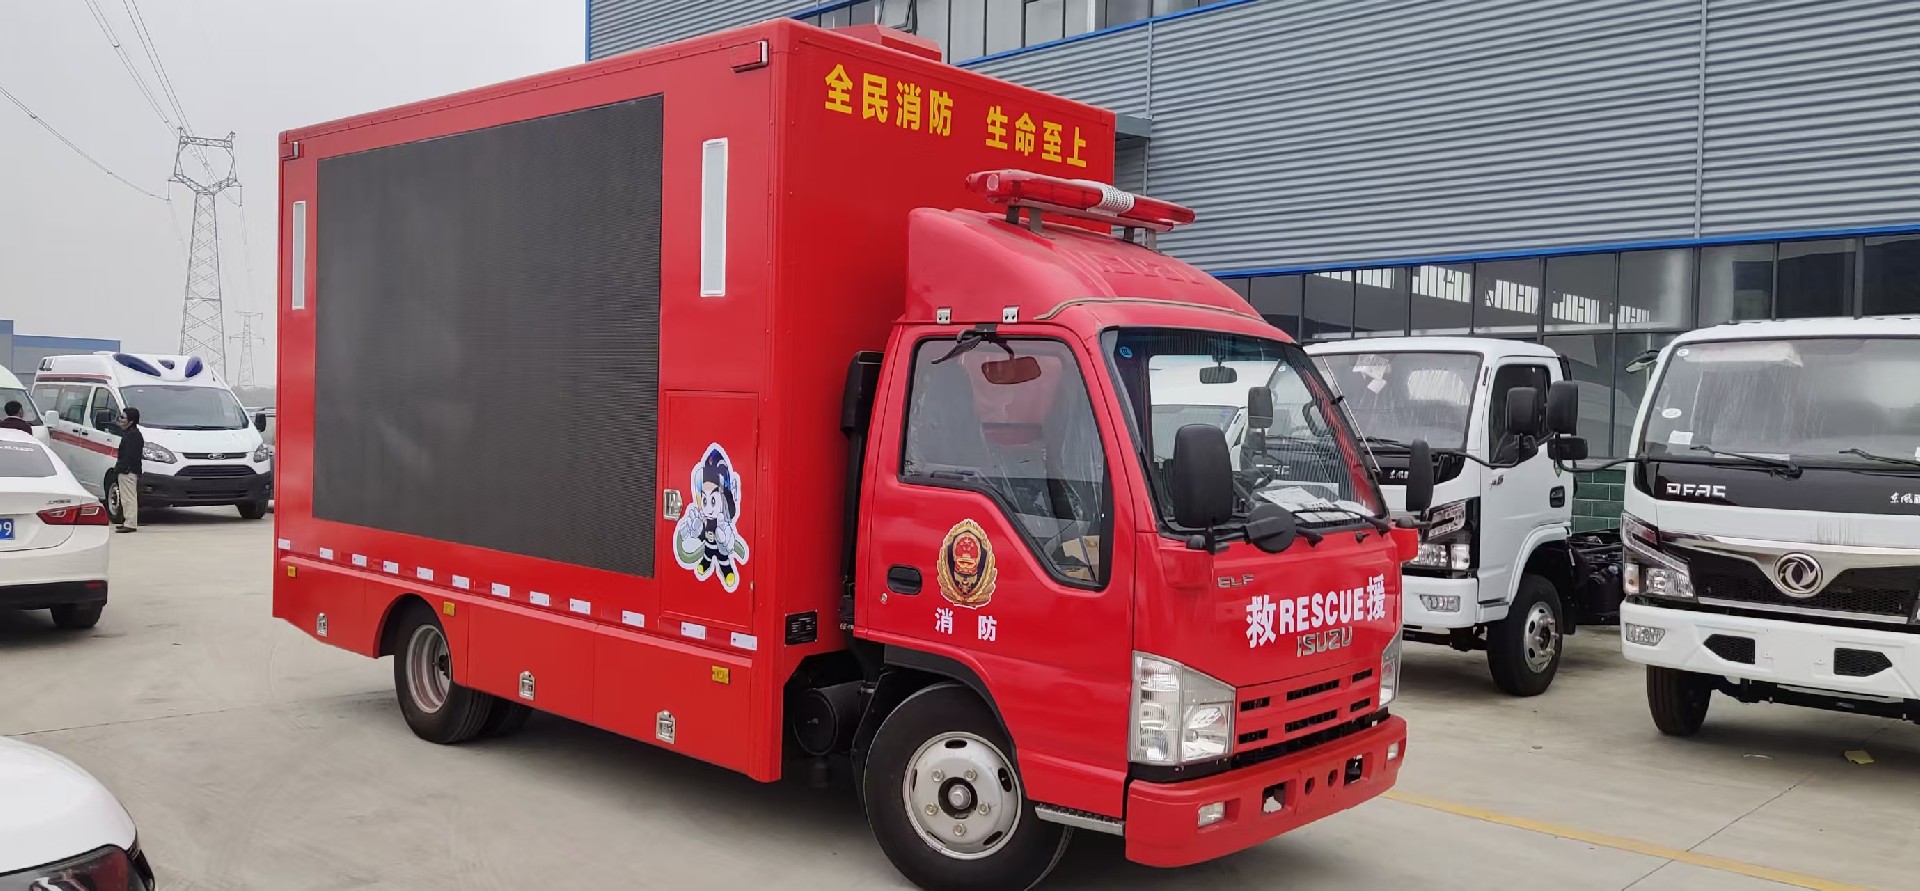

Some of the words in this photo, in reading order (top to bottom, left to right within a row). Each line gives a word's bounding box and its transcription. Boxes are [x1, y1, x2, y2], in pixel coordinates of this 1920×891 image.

[825, 64, 954, 136] 全民消防
[986, 106, 1088, 168] 生命至上
[1217, 574, 1255, 588] ELF
[1297, 626, 1353, 658] ISUZU
